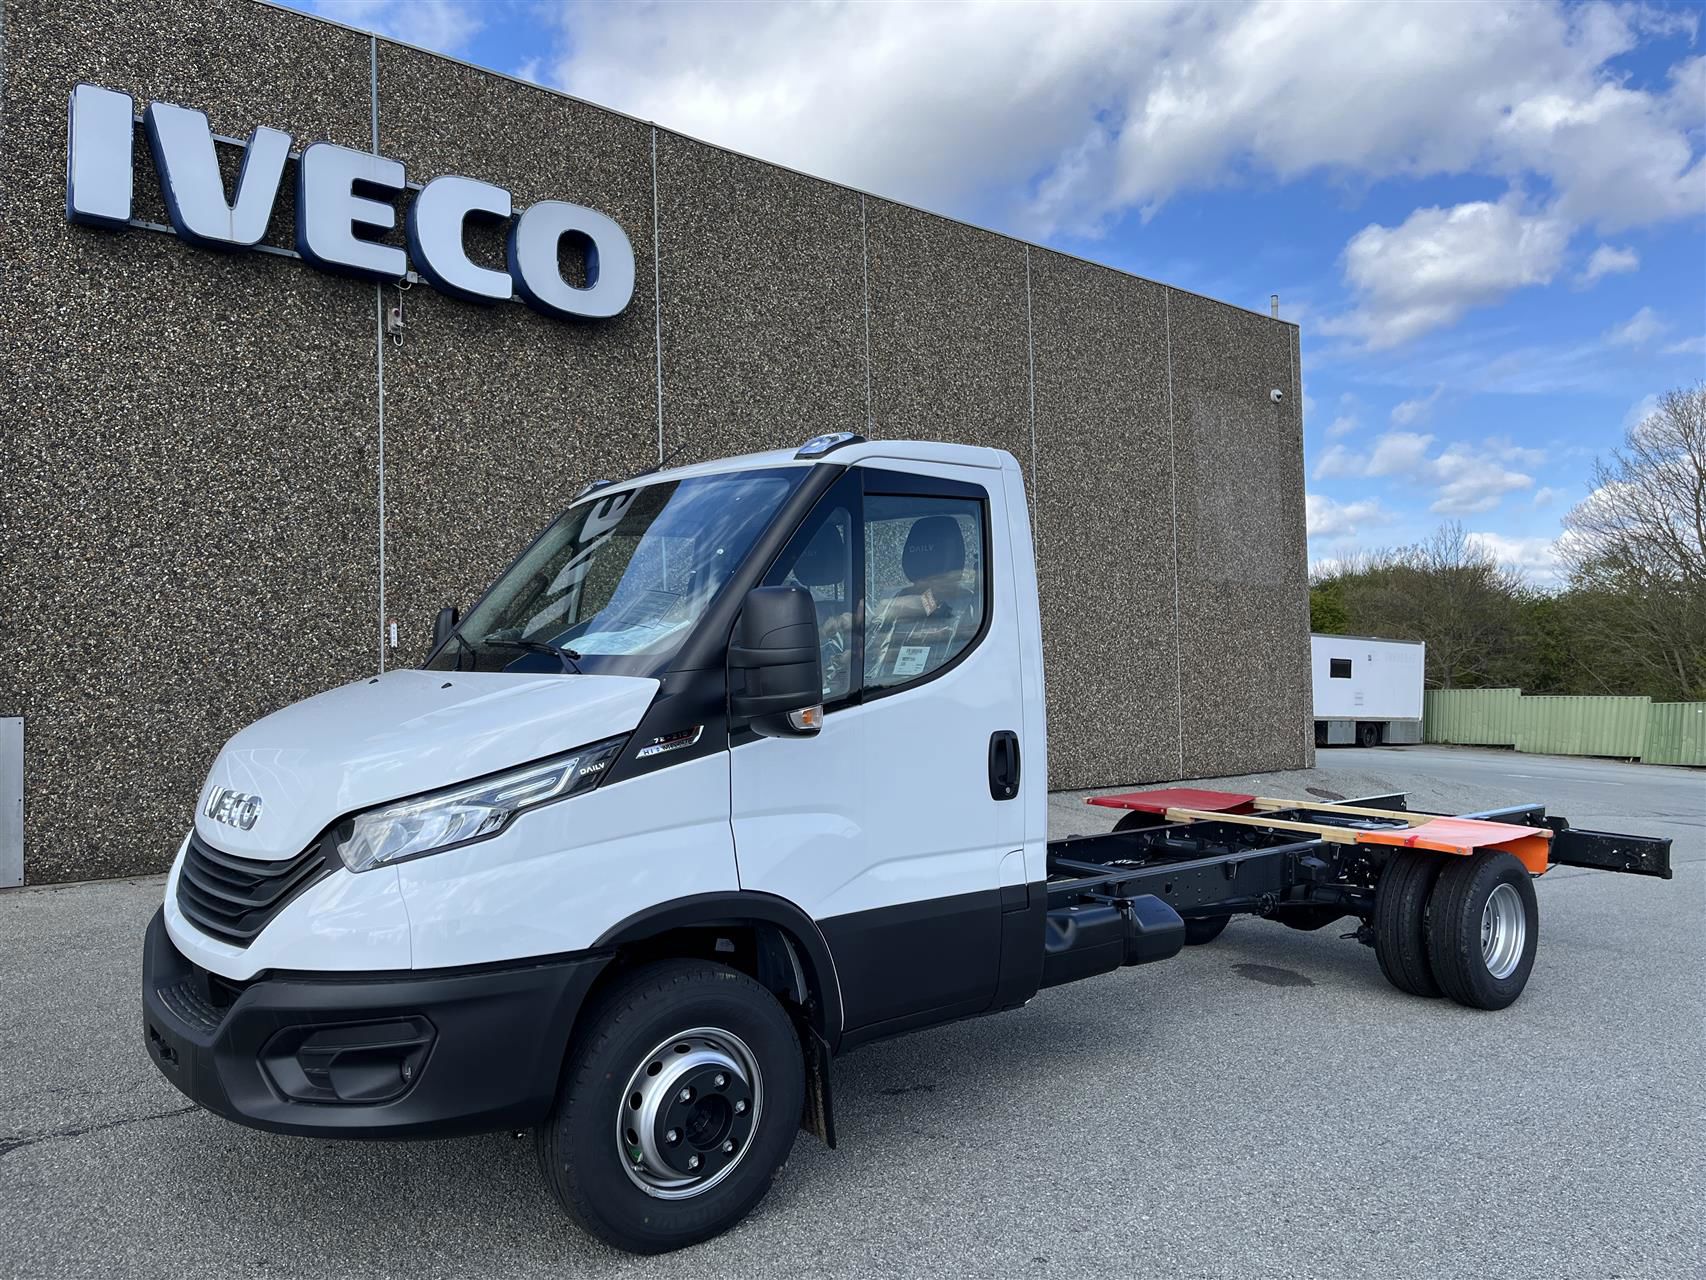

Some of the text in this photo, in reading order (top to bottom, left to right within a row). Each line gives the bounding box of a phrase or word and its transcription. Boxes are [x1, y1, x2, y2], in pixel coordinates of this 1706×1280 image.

[67, 82, 636, 320] IVECO
[909, 543, 935, 553] DAILY
[580, 762, 605, 775] DAILY
[203, 785, 262, 831] IVECO
